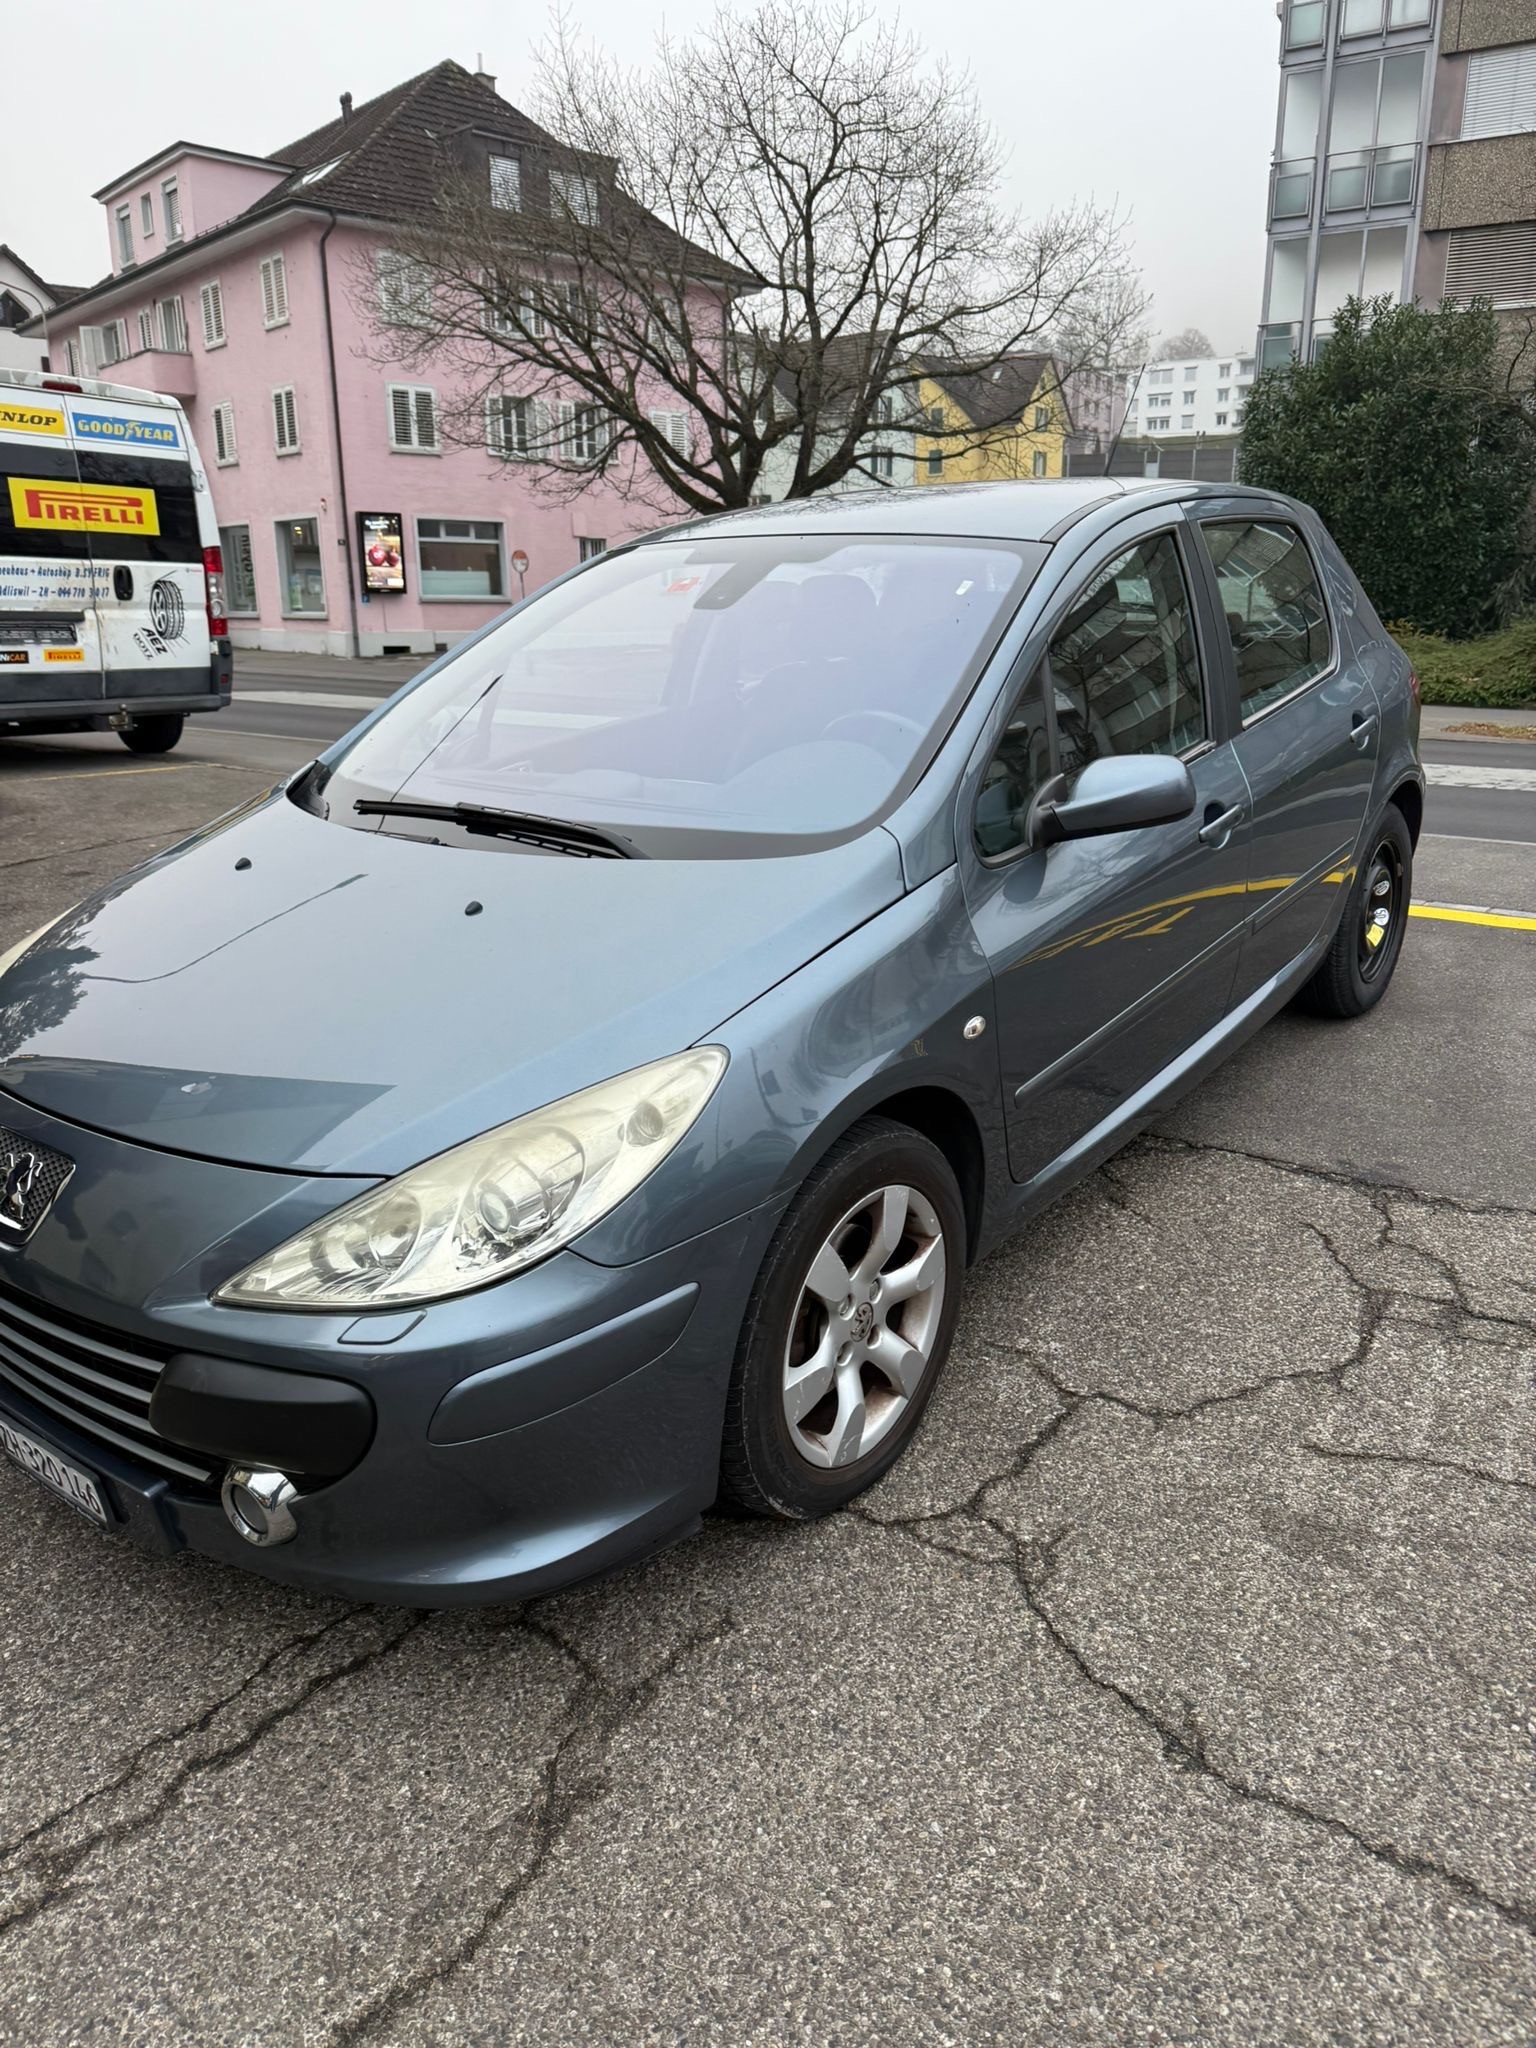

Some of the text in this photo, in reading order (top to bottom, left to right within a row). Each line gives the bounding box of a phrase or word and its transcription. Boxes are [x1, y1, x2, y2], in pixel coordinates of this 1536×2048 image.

[0, 411, 57, 426] NLOP
[78, 420, 174, 441] GOODYEAR
[25, 489, 144, 525] PIRELLI
[37, 566, 71, 579] Autoshop
[141, 627, 168, 655] AEZ
